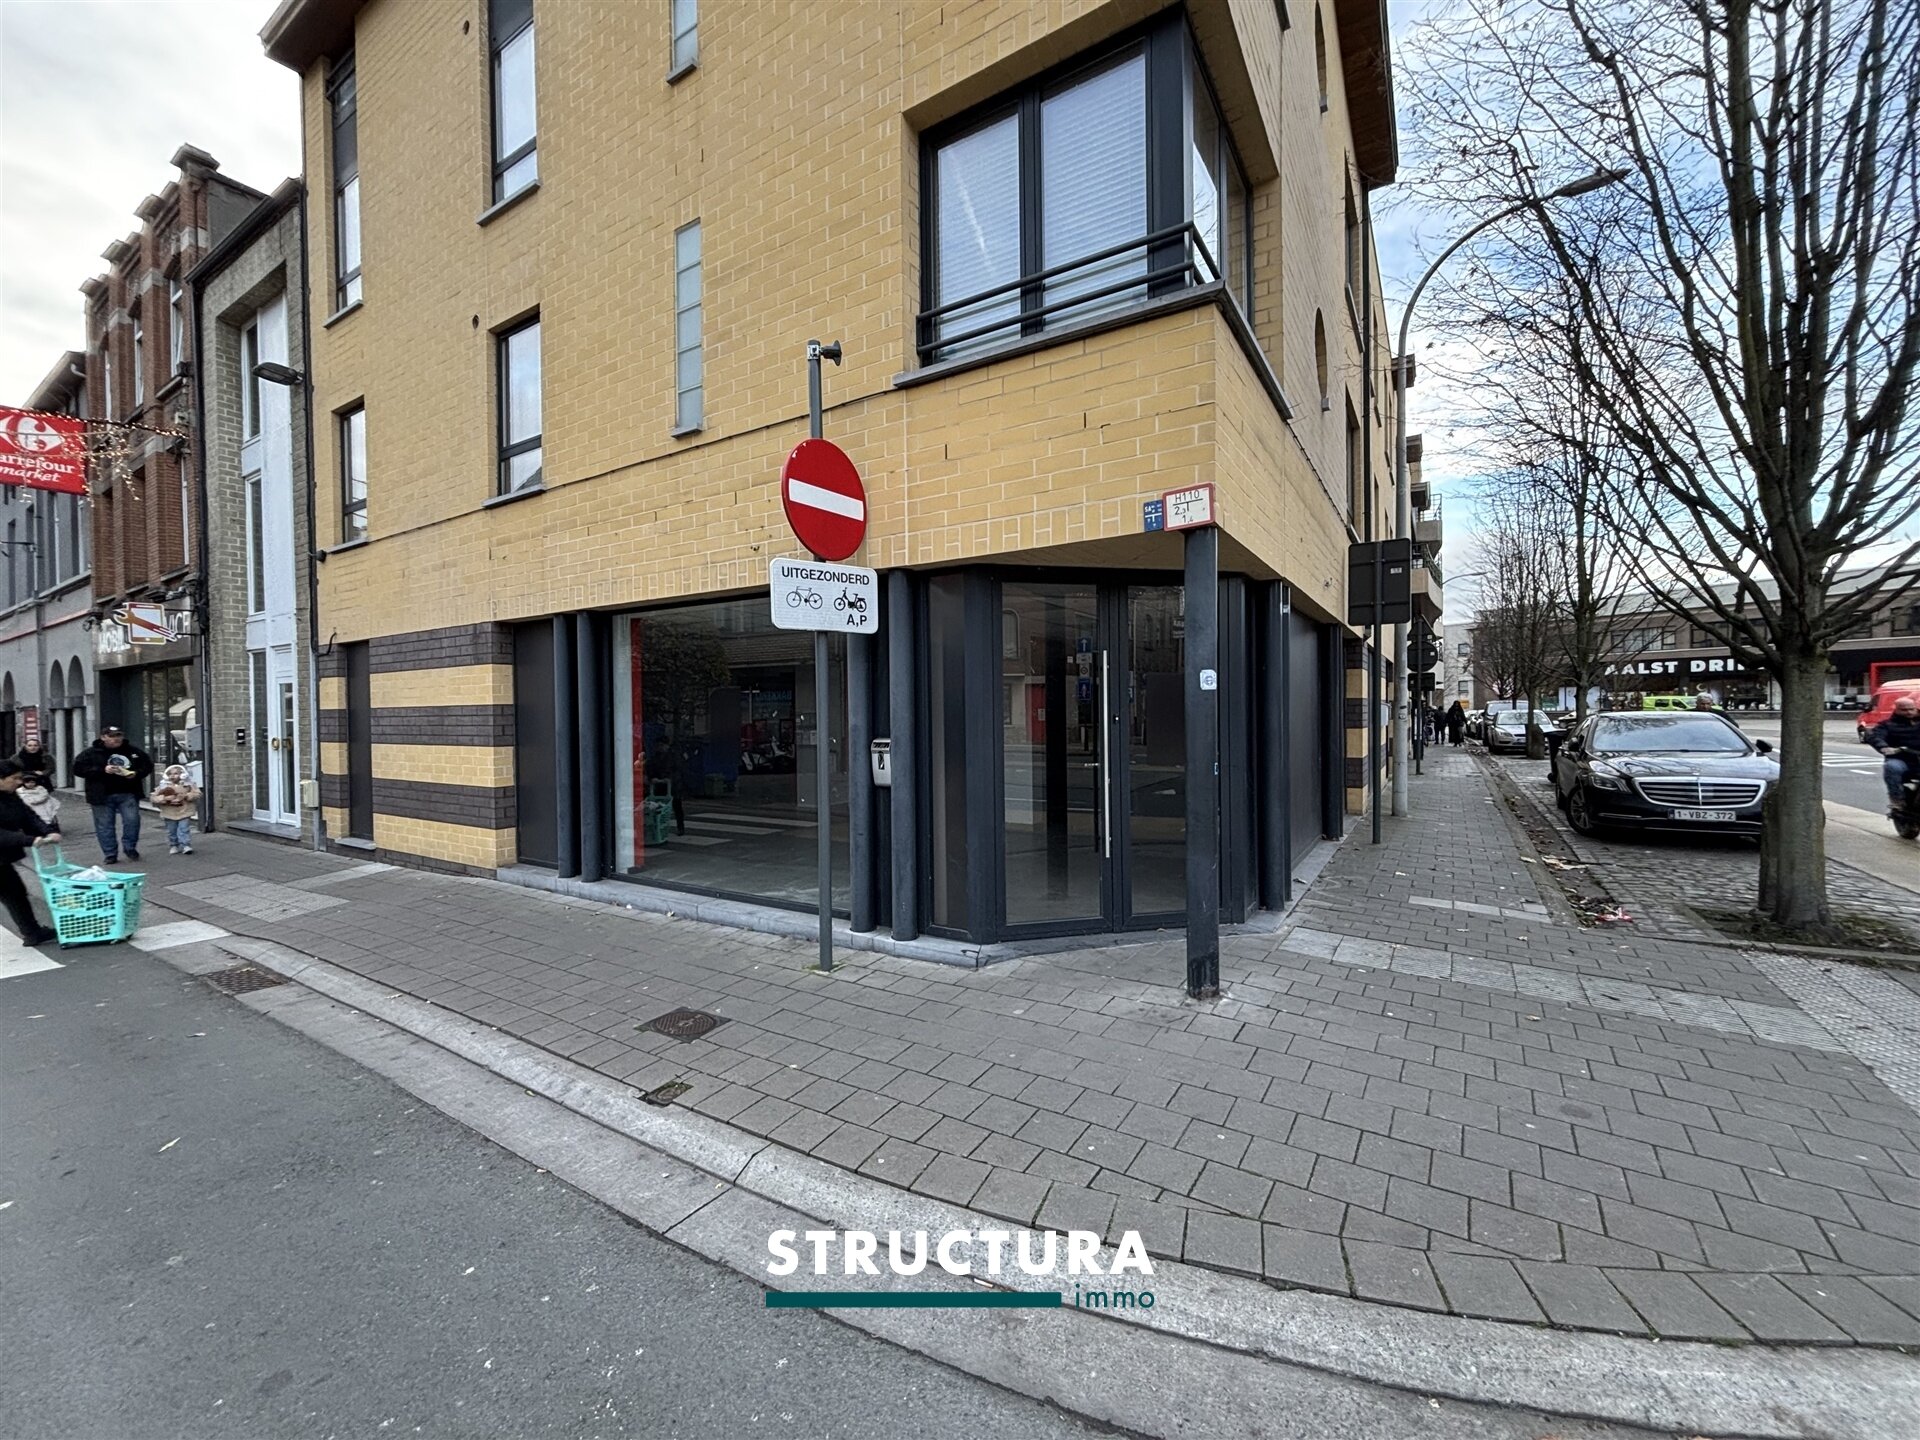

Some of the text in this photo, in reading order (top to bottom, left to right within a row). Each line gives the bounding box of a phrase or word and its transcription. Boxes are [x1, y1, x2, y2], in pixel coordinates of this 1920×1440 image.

[0, 454, 74, 474] arrefour
[0, 466, 61, 482] market
[1175, 489, 1200, 503] H110
[781, 566, 870, 586] UITGEZONDERD
[846, 613, 868, 627] A,P
[1604, 660, 1679, 676] AALST
[1676, 810, 1734, 820] 1-VBZ-372
